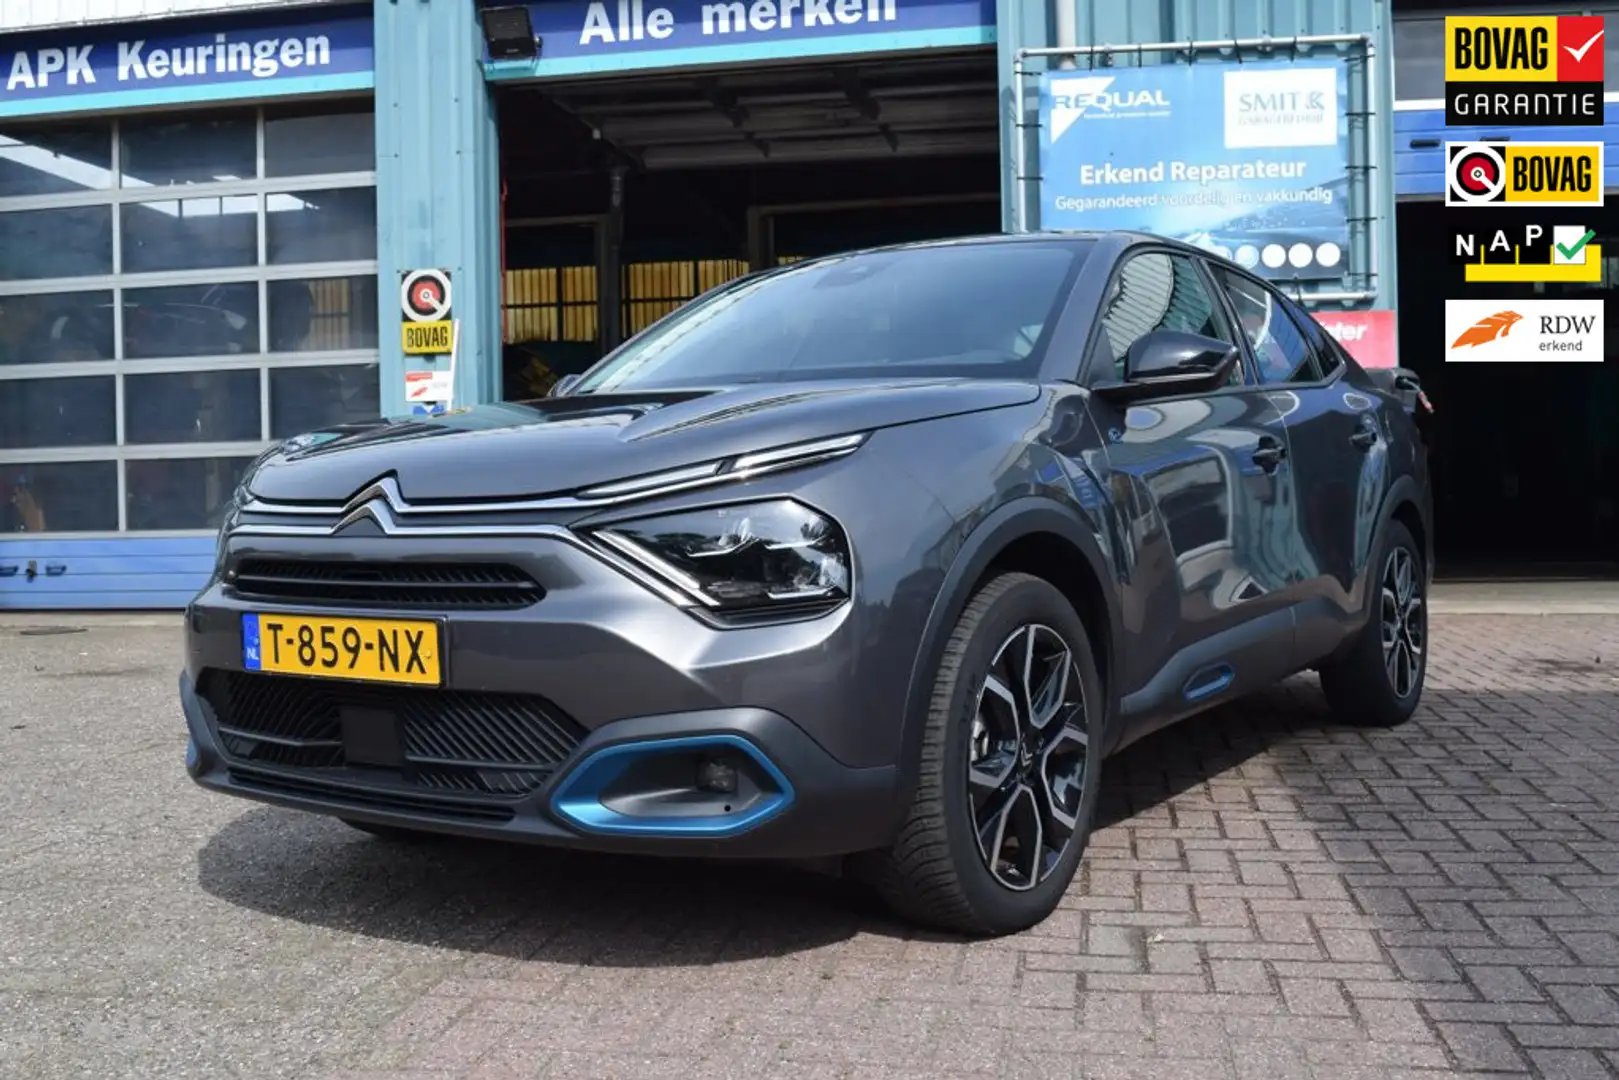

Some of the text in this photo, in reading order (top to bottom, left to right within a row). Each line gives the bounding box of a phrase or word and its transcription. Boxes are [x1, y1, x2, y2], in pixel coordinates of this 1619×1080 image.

[579, 0, 674, 45] Alle
[7, 33, 330, 90] APK Keuringen
[1238, 91, 1299, 113] SMIT
[1080, 159, 1307, 186] Erkend Reparateur
[1055, 193, 1158, 213] Gegarandeerd
[1256, 186, 1333, 206] vakkundig
[406, 326, 448, 348] BOVAG
[267, 623, 426, 674] T-859-NX
